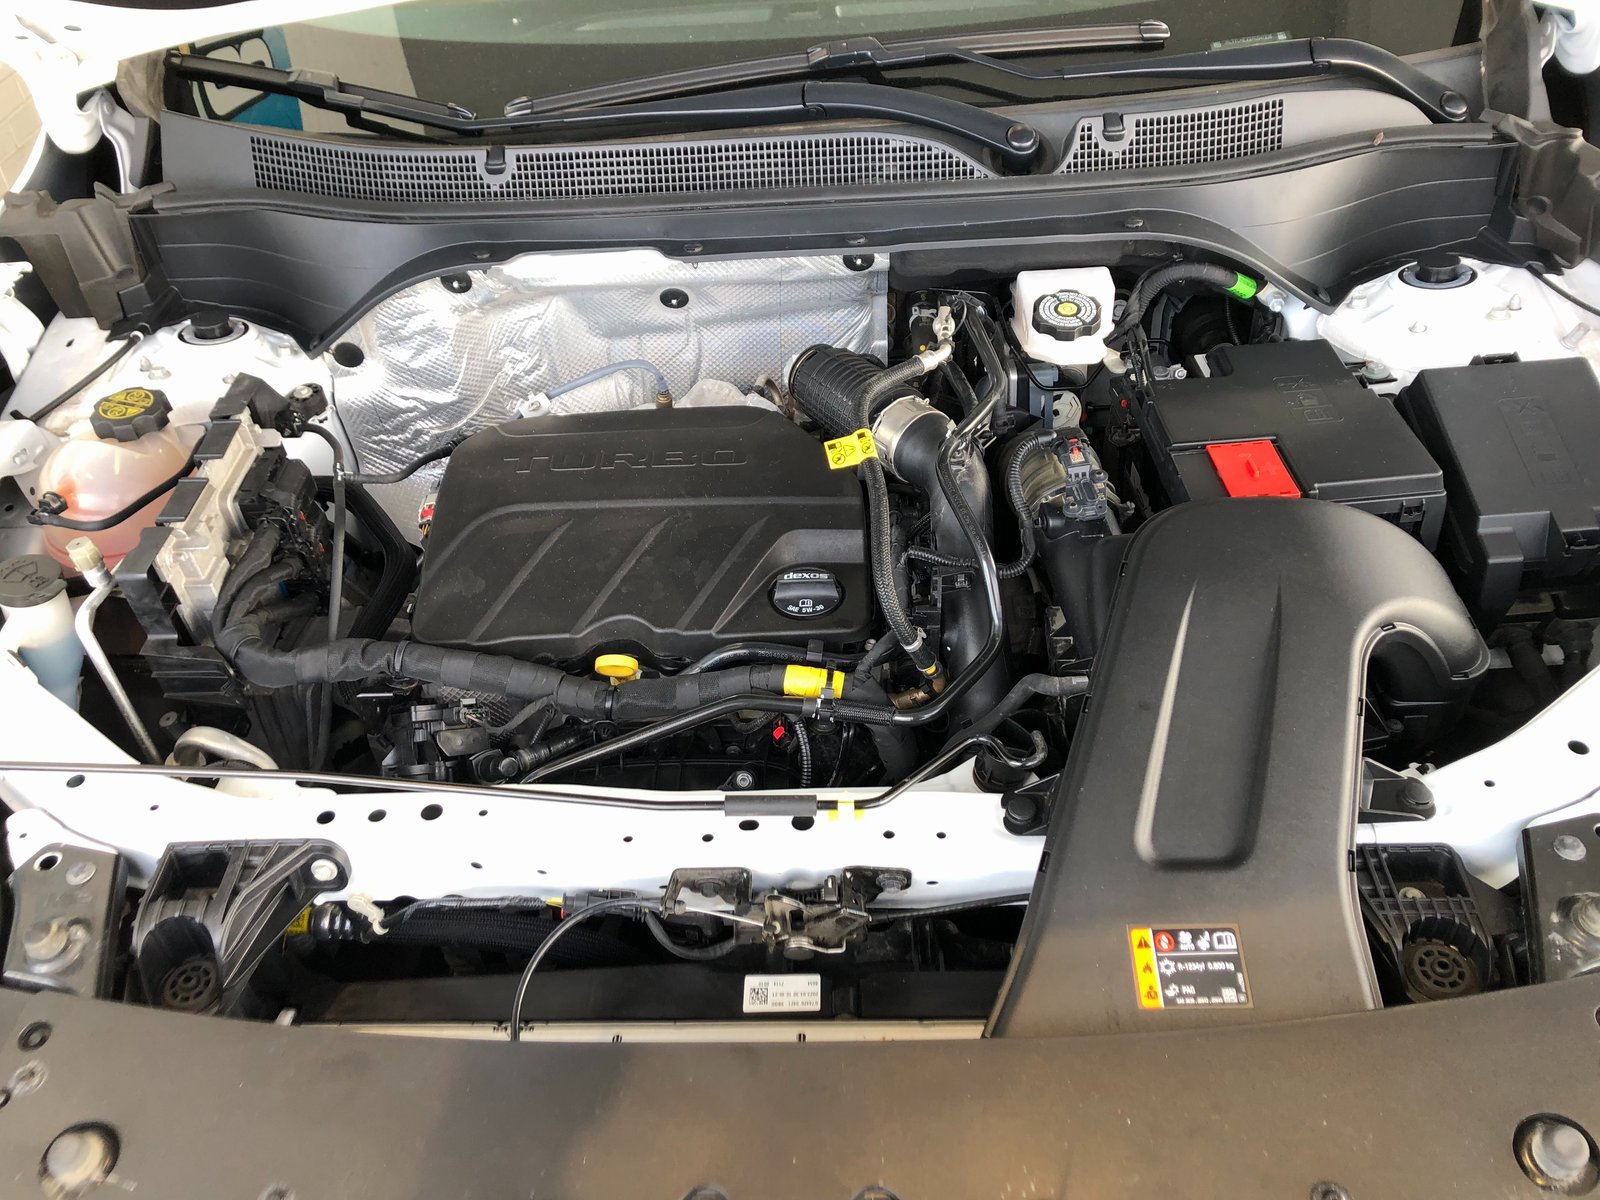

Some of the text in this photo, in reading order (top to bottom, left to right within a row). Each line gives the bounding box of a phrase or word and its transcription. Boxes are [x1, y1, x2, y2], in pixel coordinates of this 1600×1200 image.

[503, 449, 748, 473] TURBO
[783, 572, 830, 580] dexos
[787, 604, 825, 613] SAE 5W-30
